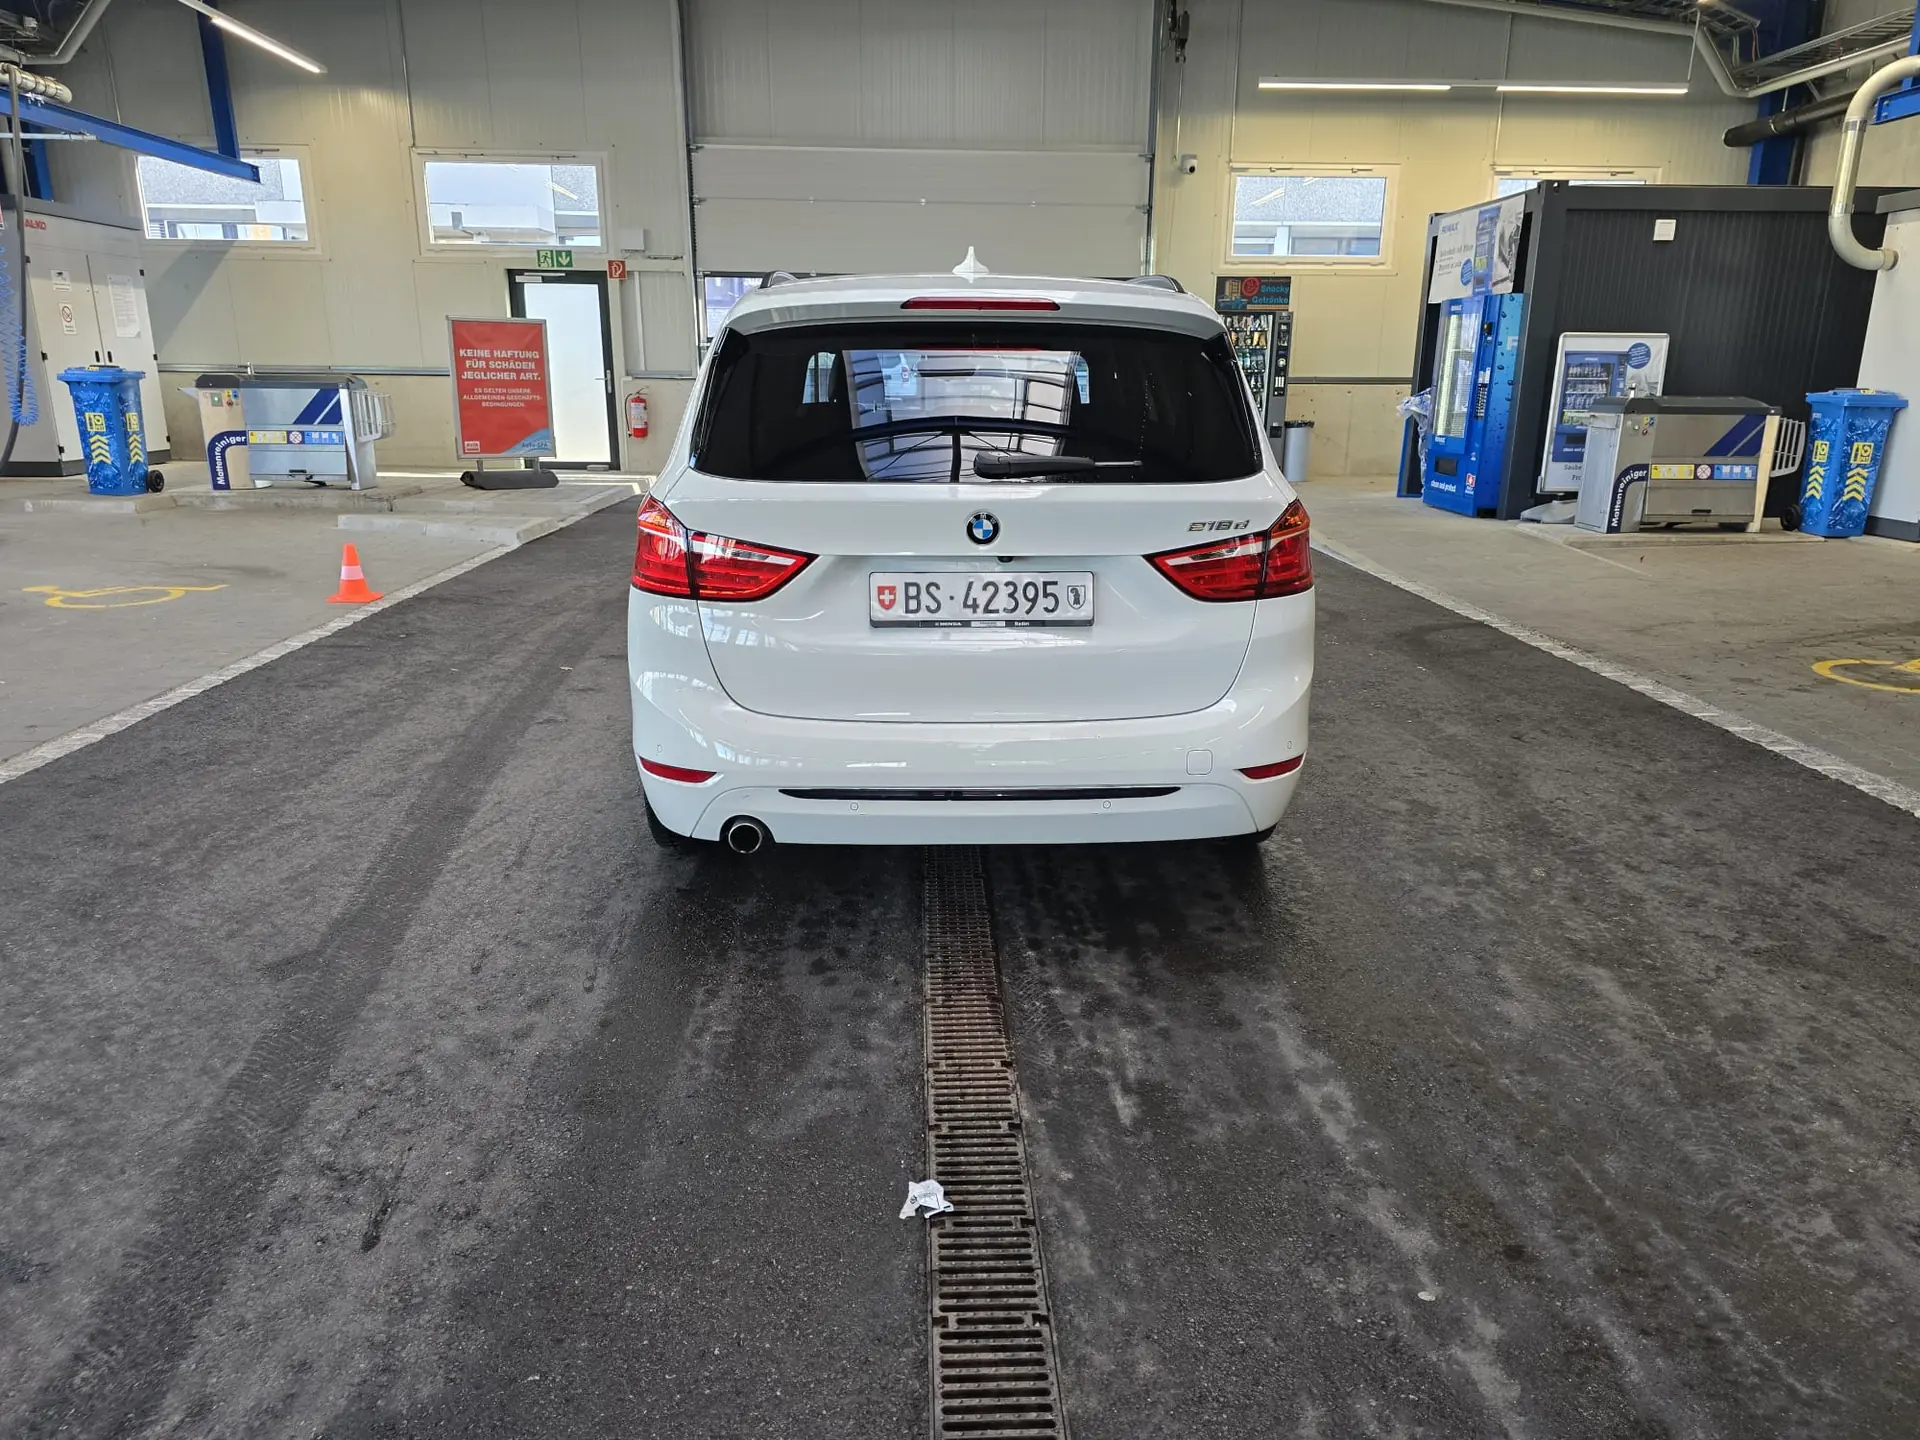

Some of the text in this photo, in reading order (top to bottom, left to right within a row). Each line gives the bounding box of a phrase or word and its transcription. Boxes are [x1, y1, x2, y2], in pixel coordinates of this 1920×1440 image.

[459, 348, 540, 359] KEINE HAFTUNG
[465, 358, 536, 370] FÜR SCHÄDEN
[461, 371, 541, 381] JEGLICHER ART.
[214, 435, 247, 486] Mattenreiniger
[1611, 468, 1648, 528] Mattenreiniger
[904, 580, 1060, 615] BS 42395
